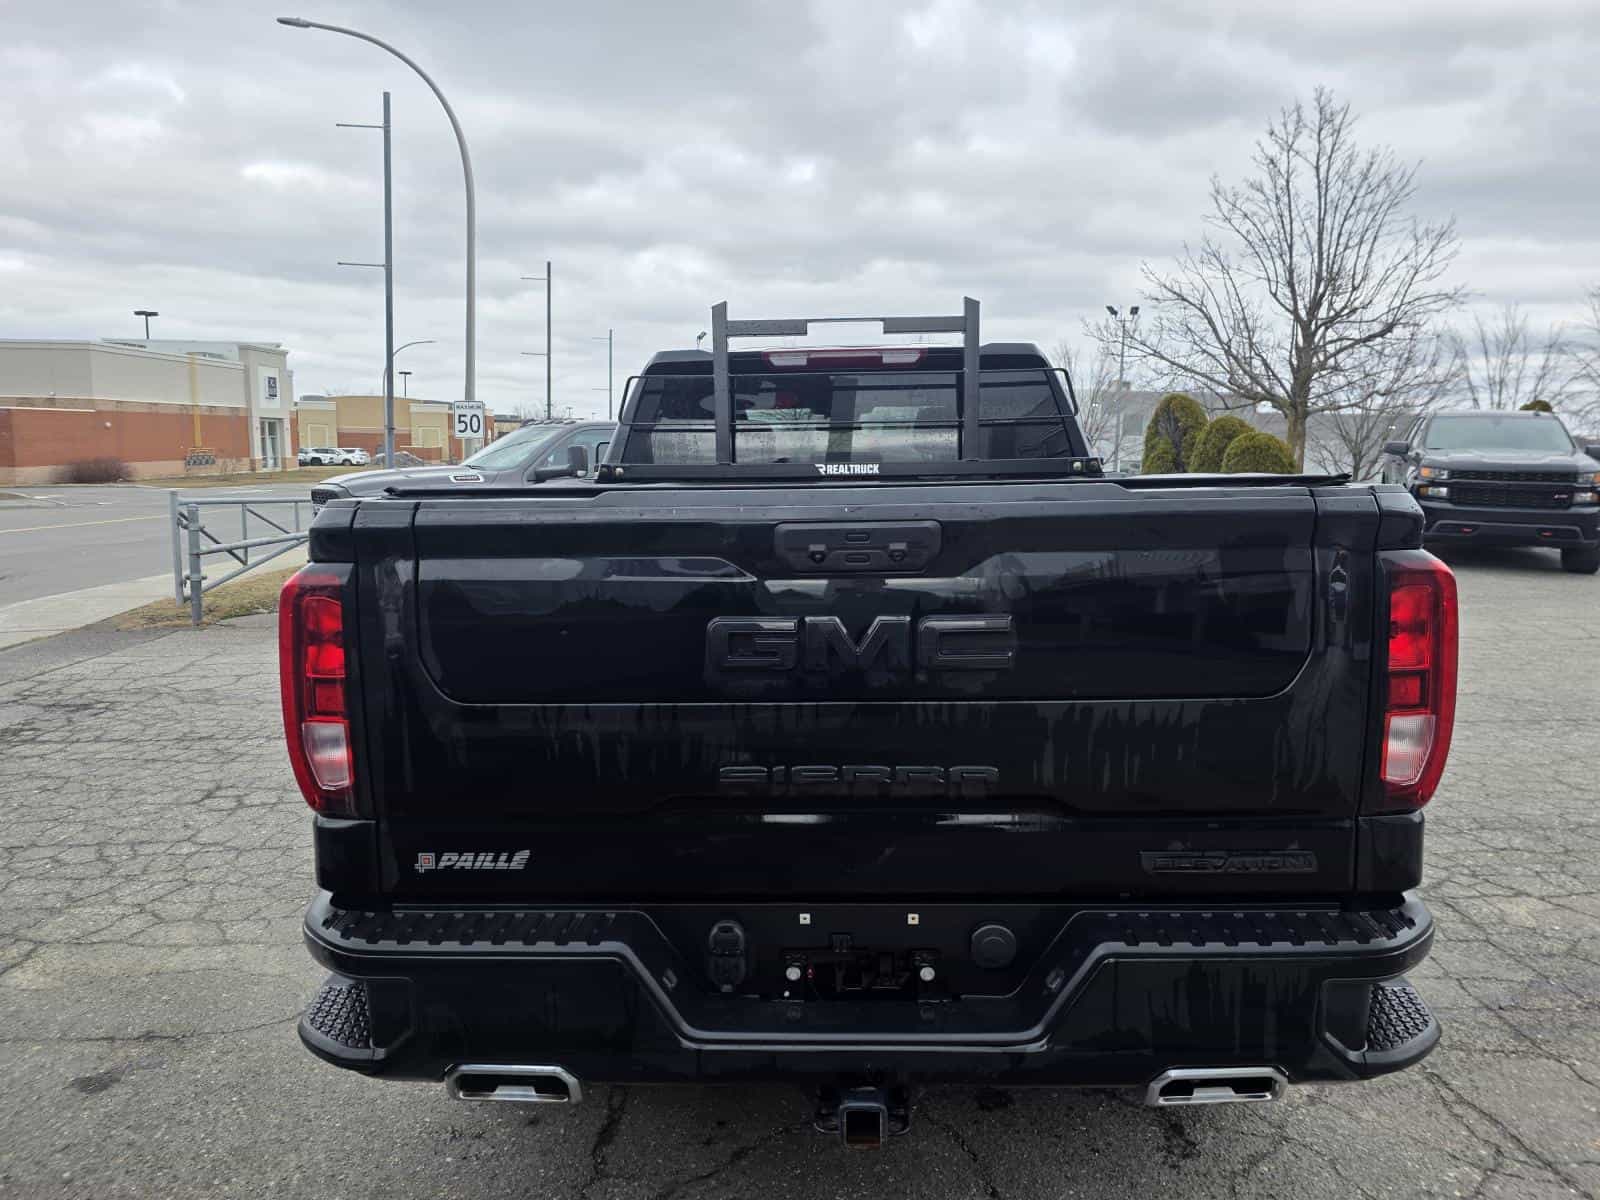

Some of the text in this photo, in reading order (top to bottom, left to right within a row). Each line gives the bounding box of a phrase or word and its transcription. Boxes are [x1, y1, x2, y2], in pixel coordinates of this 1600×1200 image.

[458, 414, 480, 433] 50
[826, 463, 880, 475] REALTRUCK
[705, 615, 1015, 669] GMC
[719, 766, 999, 797] SIERRA
